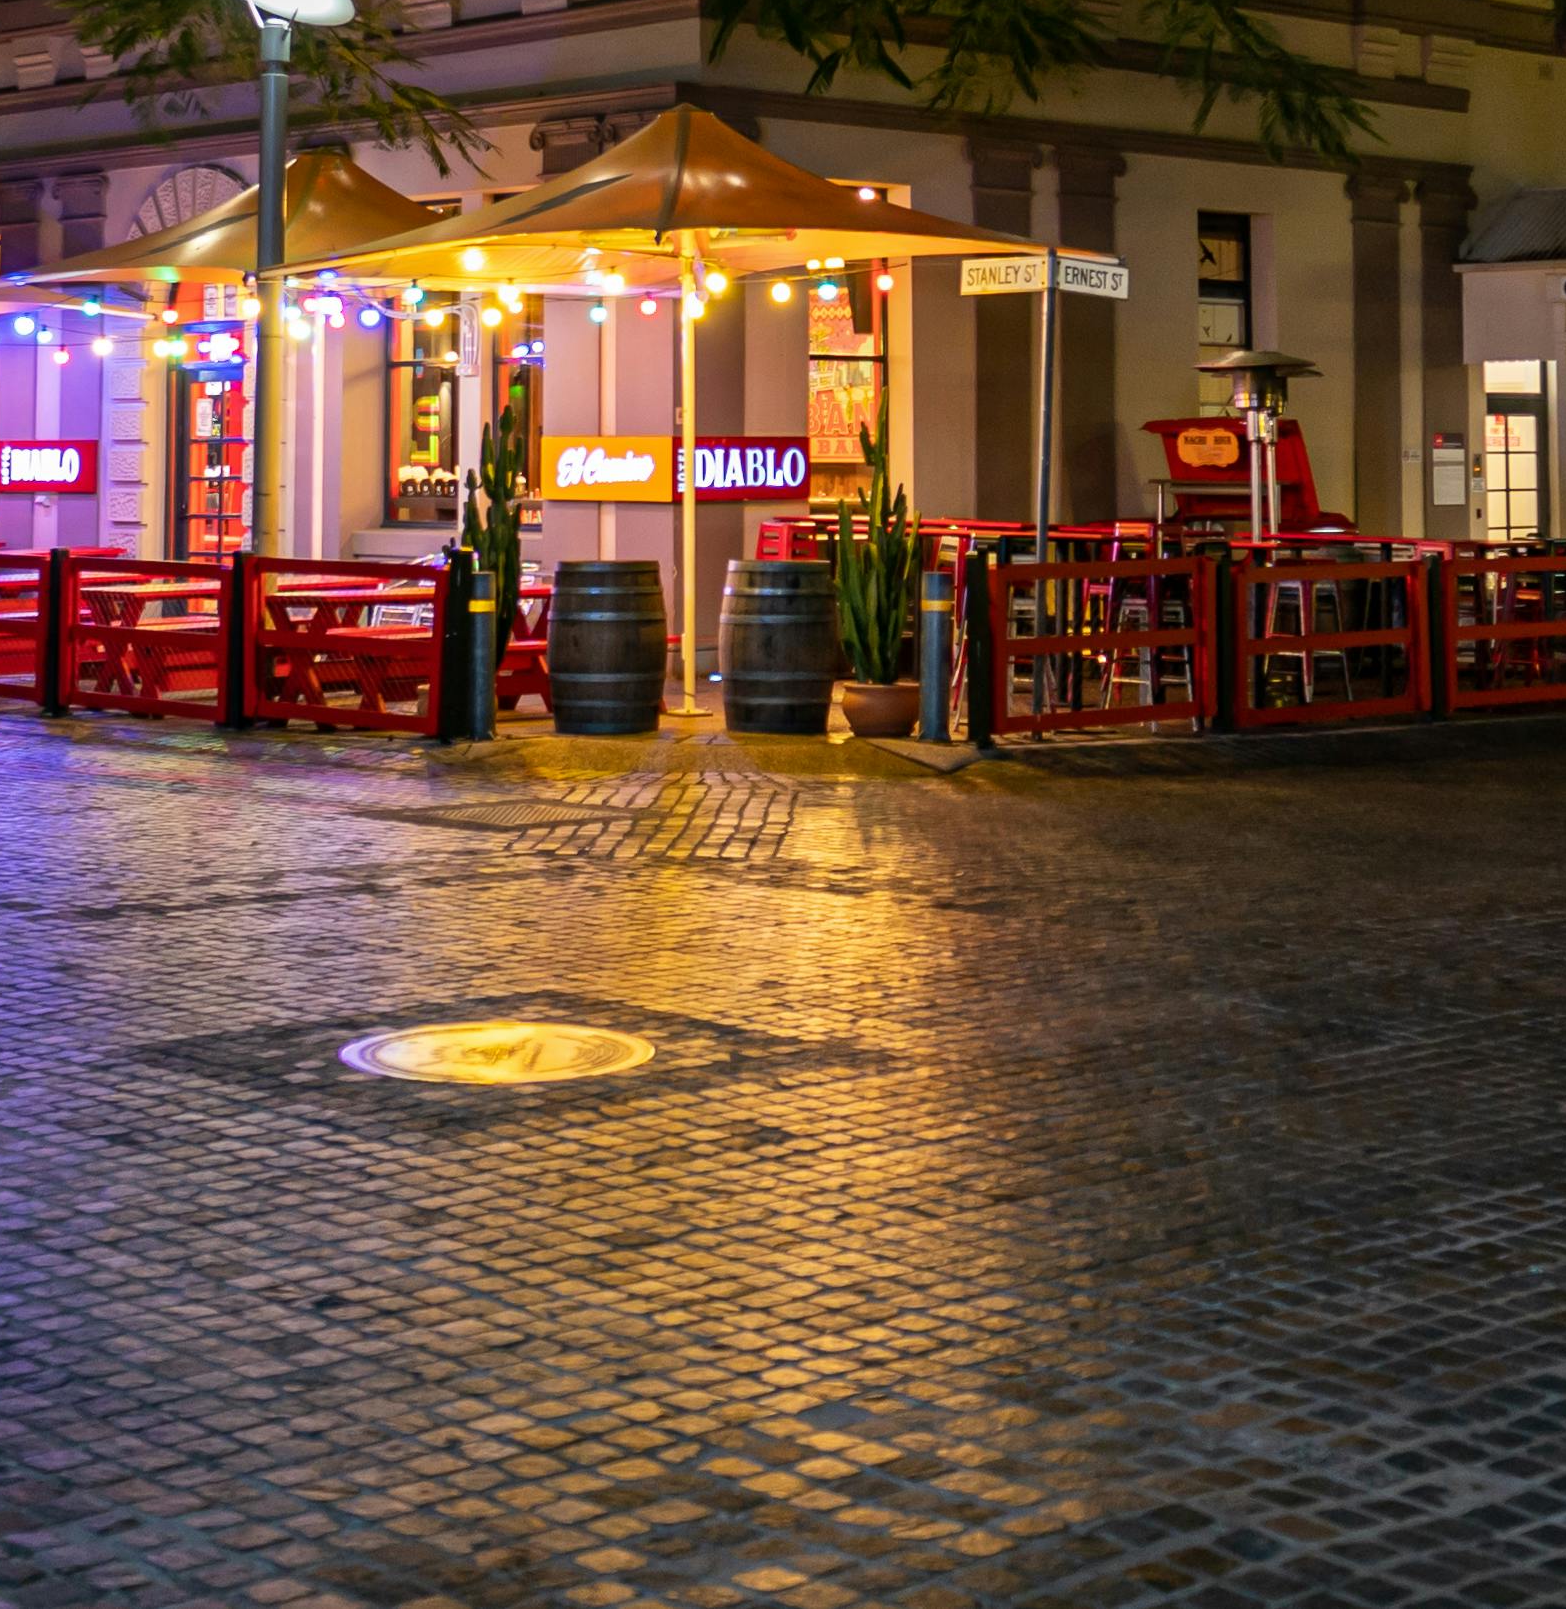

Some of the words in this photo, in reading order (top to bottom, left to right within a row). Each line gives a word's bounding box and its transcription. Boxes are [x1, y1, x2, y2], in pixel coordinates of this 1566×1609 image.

[967, 265, 1021, 286] STANLEY
[1024, 264, 1037, 283] ST
[1065, 266, 1108, 289] ERNEST
[1111, 273, 1123, 290] ST
[11, 447, 80, 482] DIABLO
[695, 448, 806, 488] DIABLO
